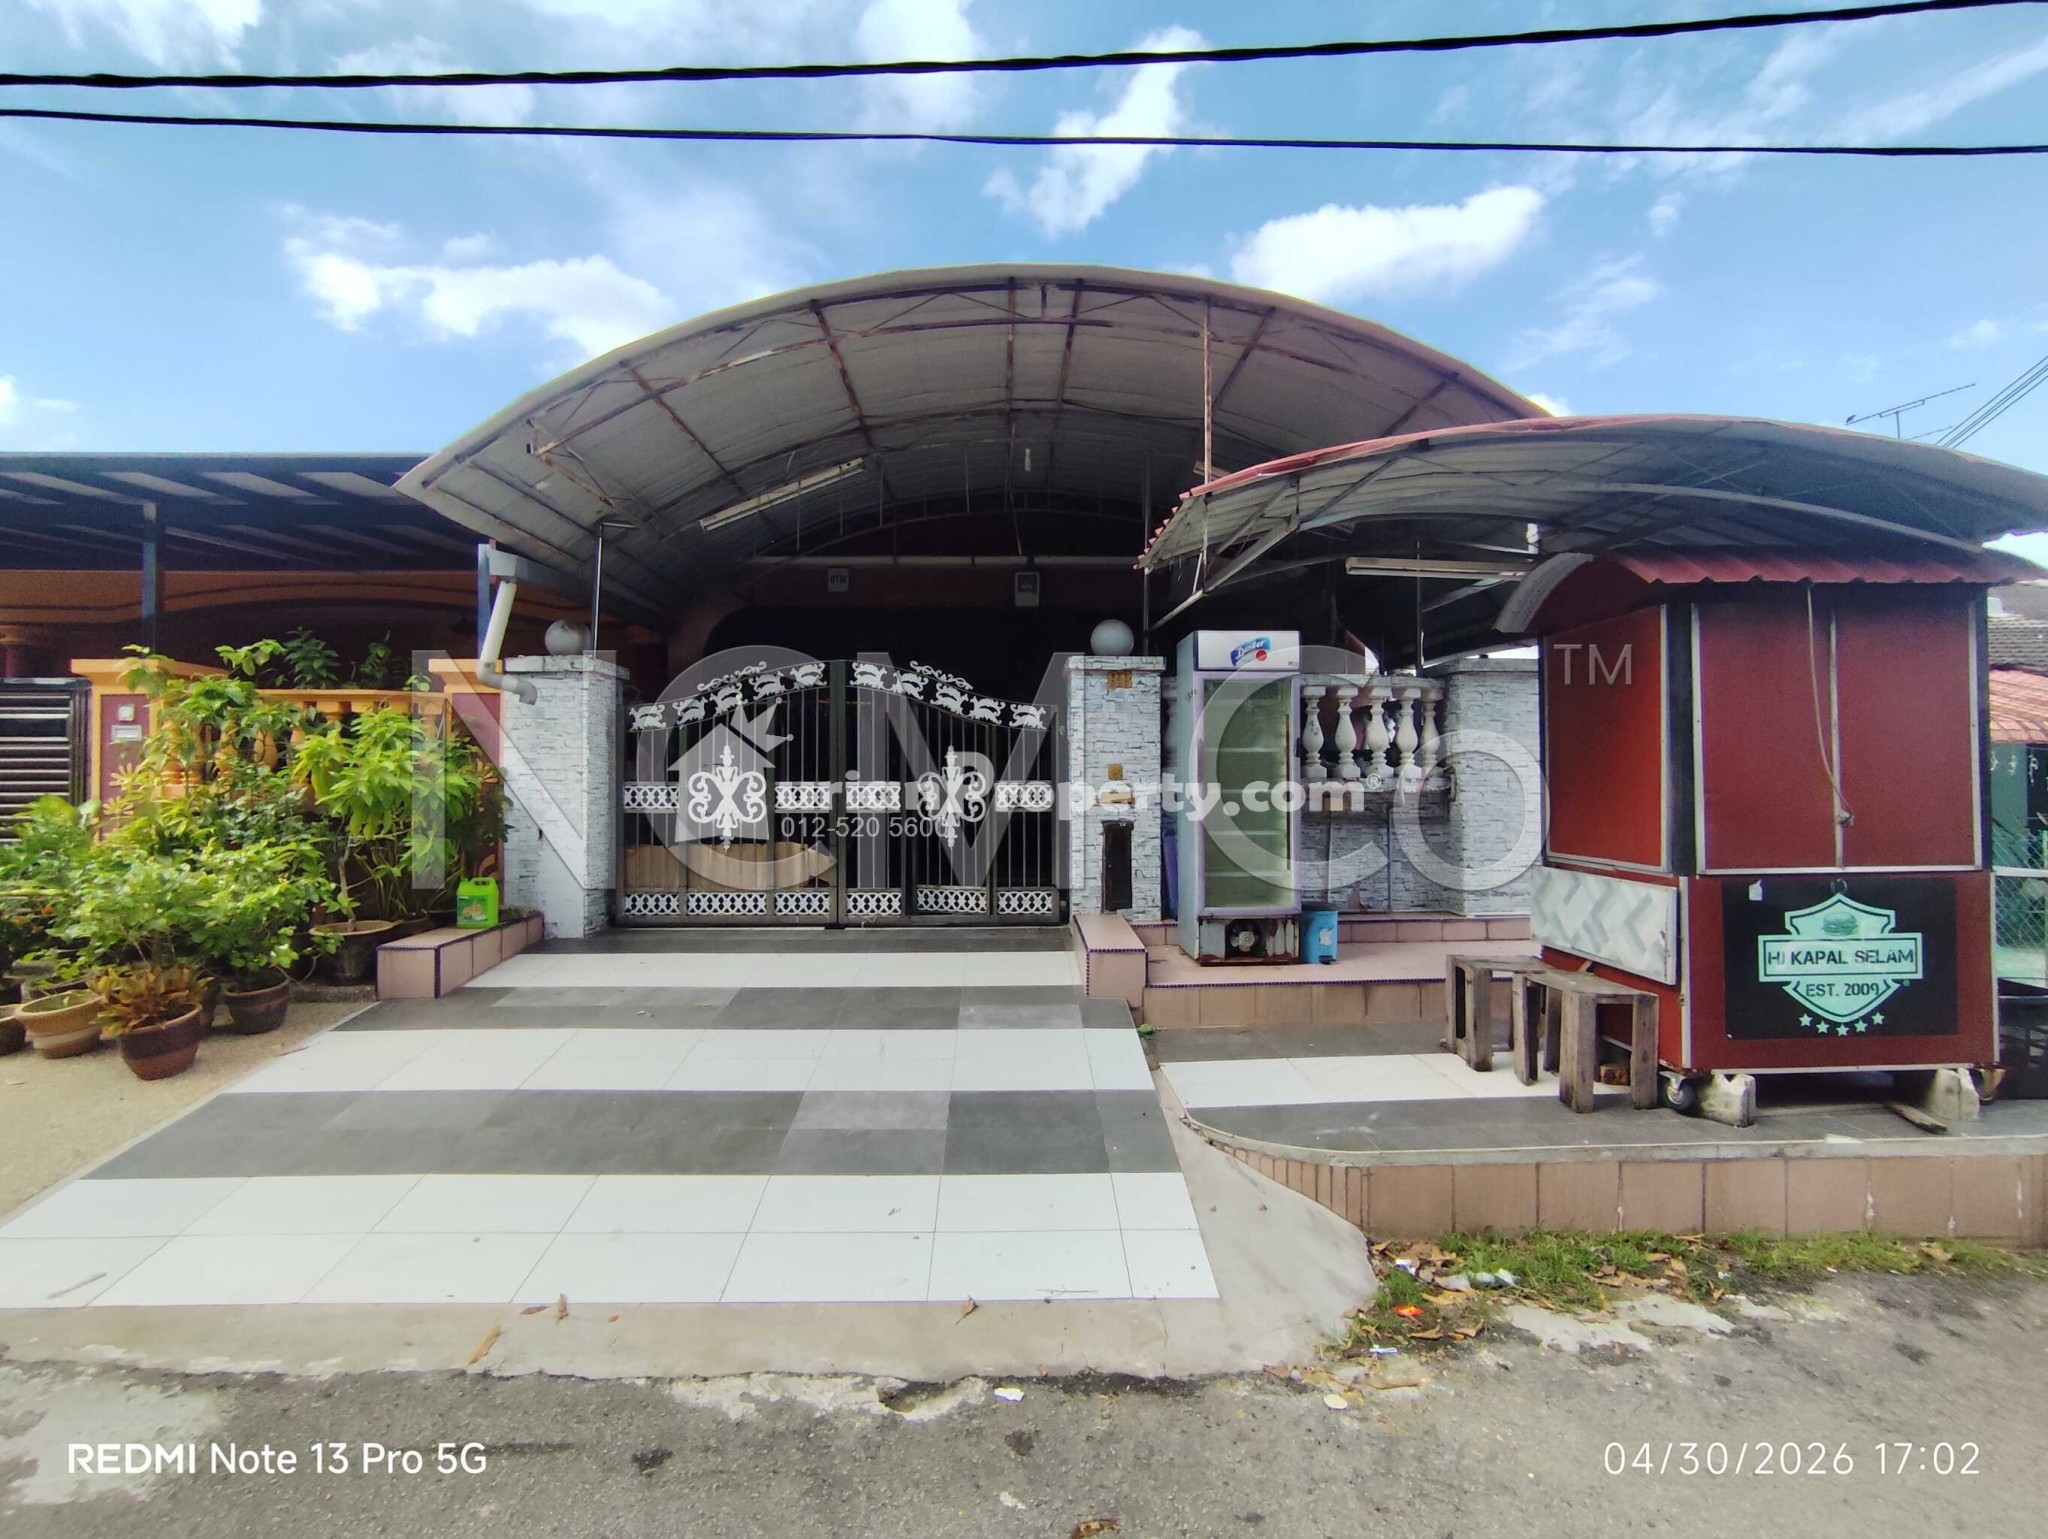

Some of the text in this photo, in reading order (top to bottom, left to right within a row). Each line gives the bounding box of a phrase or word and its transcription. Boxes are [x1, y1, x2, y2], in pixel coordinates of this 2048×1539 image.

[1791, 951, 1848, 965] KAPAL
[1855, 949, 1914, 964] SELAM
[1806, 983, 1880, 997] EST. 2009
